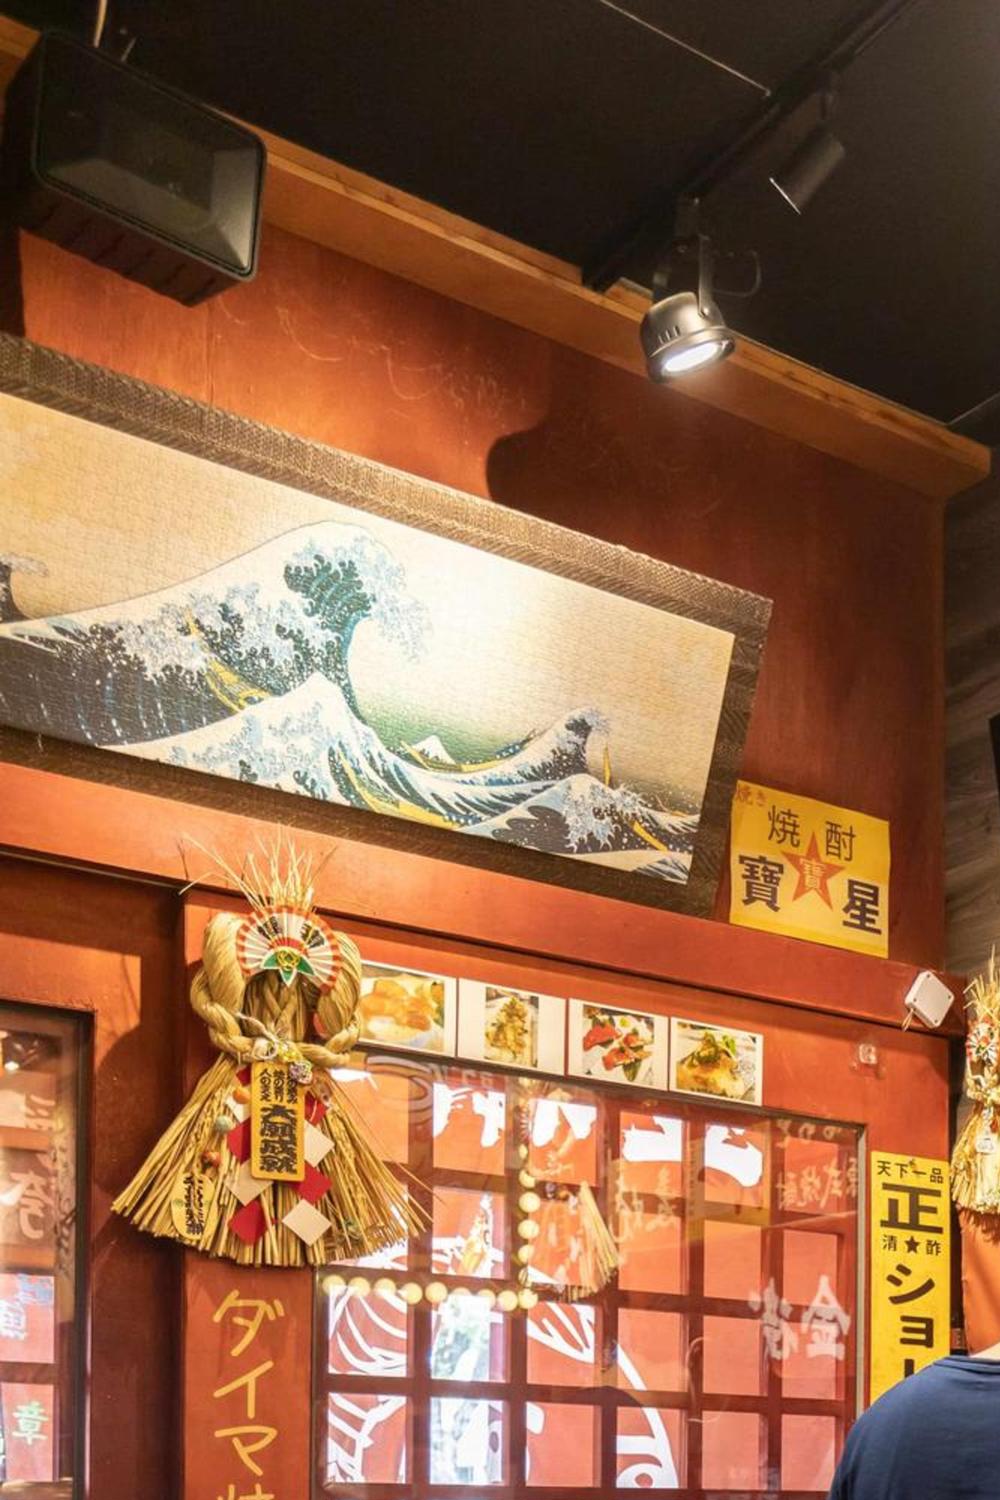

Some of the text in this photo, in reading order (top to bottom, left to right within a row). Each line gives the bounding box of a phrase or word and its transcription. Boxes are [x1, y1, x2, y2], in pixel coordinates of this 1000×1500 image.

[768, 804, 855, 862] 焼酎
[877, 1160, 944, 1184] 天下一品
[880, 1182, 944, 1234] 正
